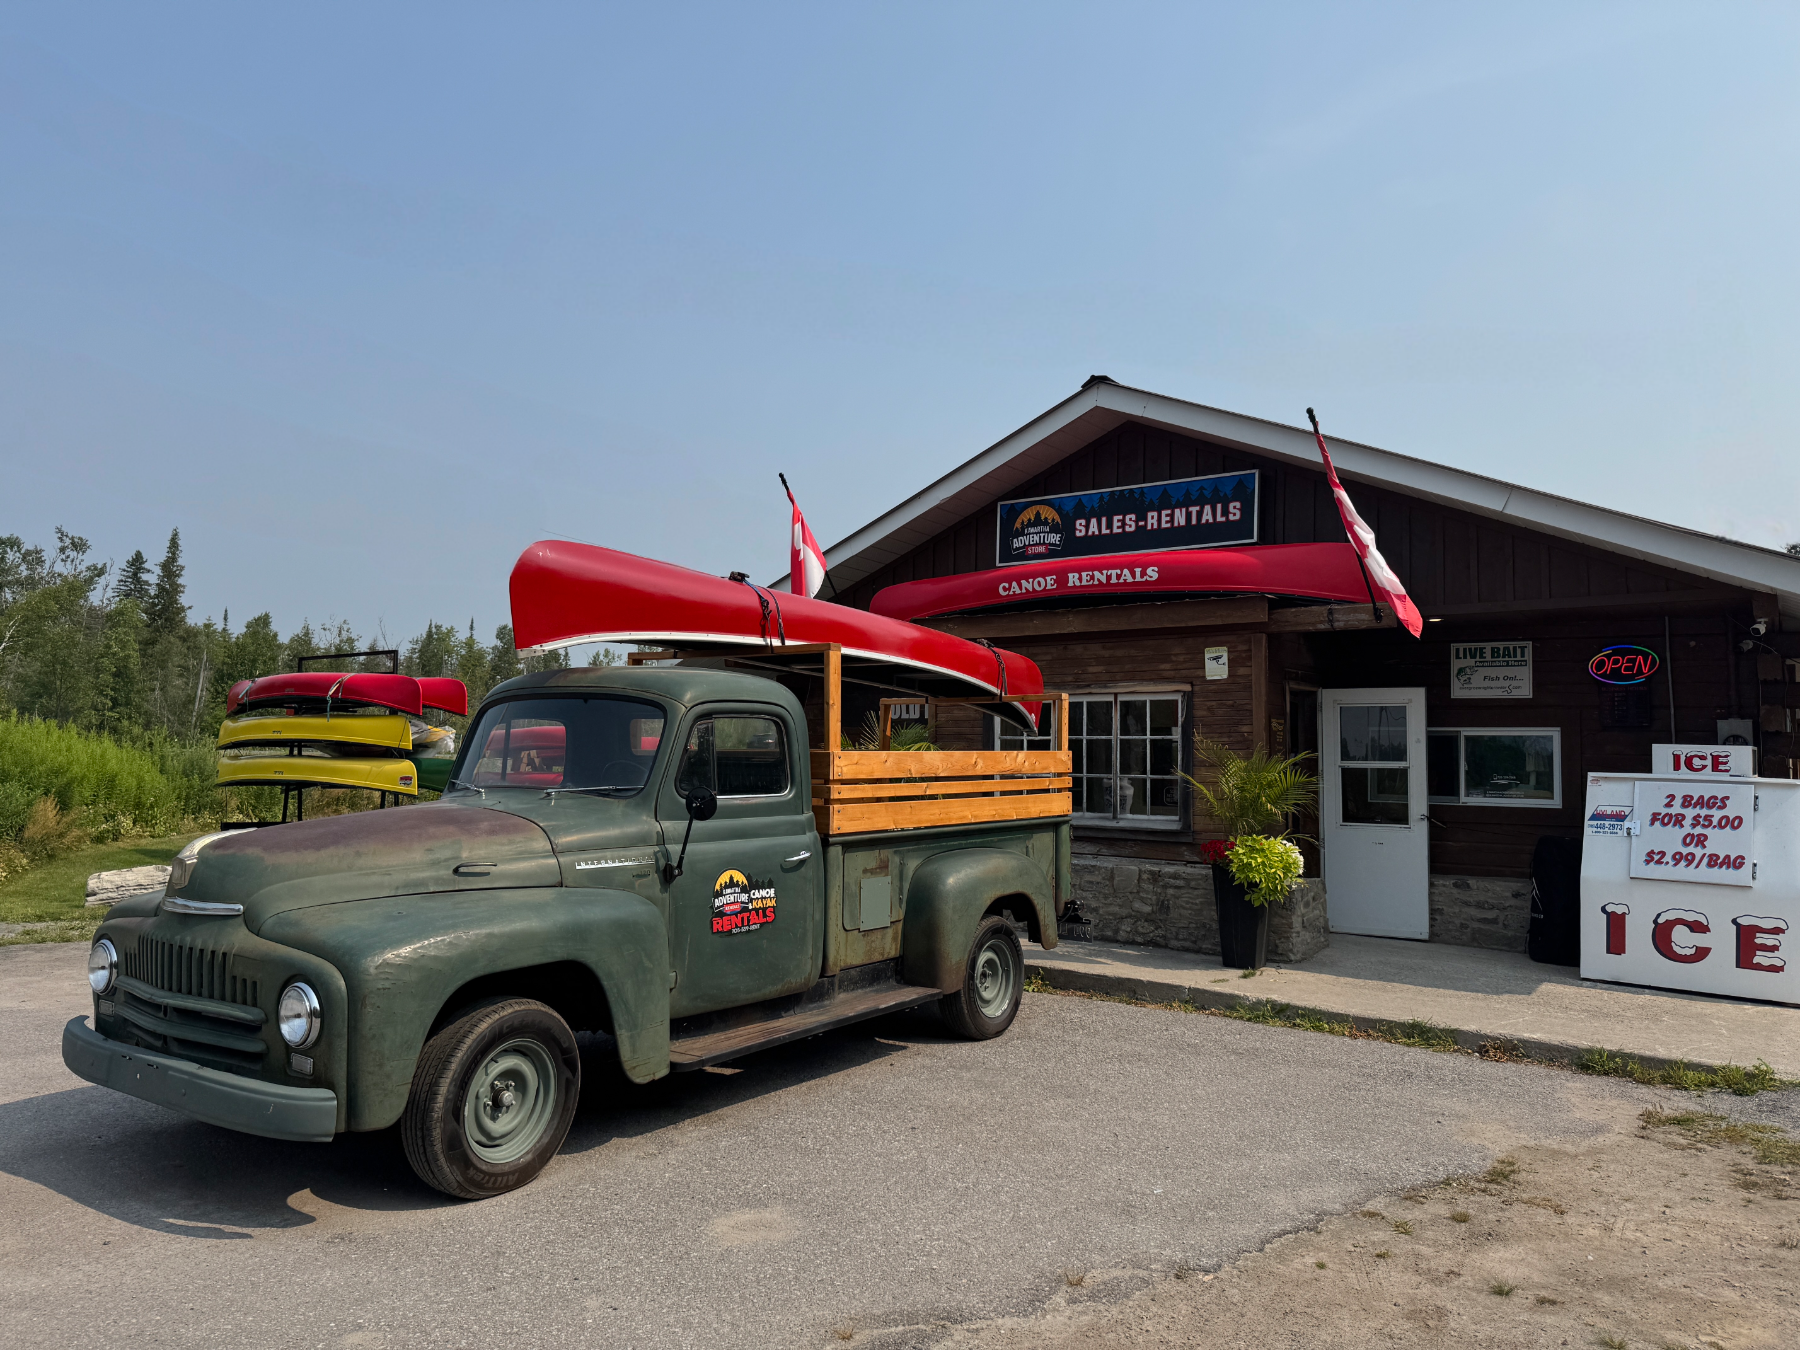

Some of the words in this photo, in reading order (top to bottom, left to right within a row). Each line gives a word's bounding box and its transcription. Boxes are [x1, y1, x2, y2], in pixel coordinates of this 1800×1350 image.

[1075, 501, 1242, 538] SALES-RENTALS
[1024, 525, 1050, 534] KAWARTHA
[1013, 533, 1061, 549] ADVENTURE
[1027, 545, 1047, 554] STORE
[998, 575, 1058, 596] CANOE
[1067, 566, 1159, 587] RENTALS
[1455, 646, 1487, 660] LIVE
[1490, 645, 1528, 659] BAIT
[1592, 655, 1652, 675] OPEN
[1672, 750, 1731, 772] ICE
[1663, 793, 1676, 809] 2
[1680, 794, 1730, 811] BAGS
[1595, 809, 1626, 820] HYLAND
[1649, 812, 1685, 829] FOR
[1689, 813, 1743, 831] $5.00
[1681, 833, 1708, 850] OR
[1643, 849, 1746, 870] $2.99/BAG
[714, 893, 749, 907] ADVENTURE
[750, 888, 776, 898] CANOE
[752, 898, 777, 909] KAYAK
[712, 908, 775, 933] RENTALS
[1601, 901, 1789, 974] ICE
